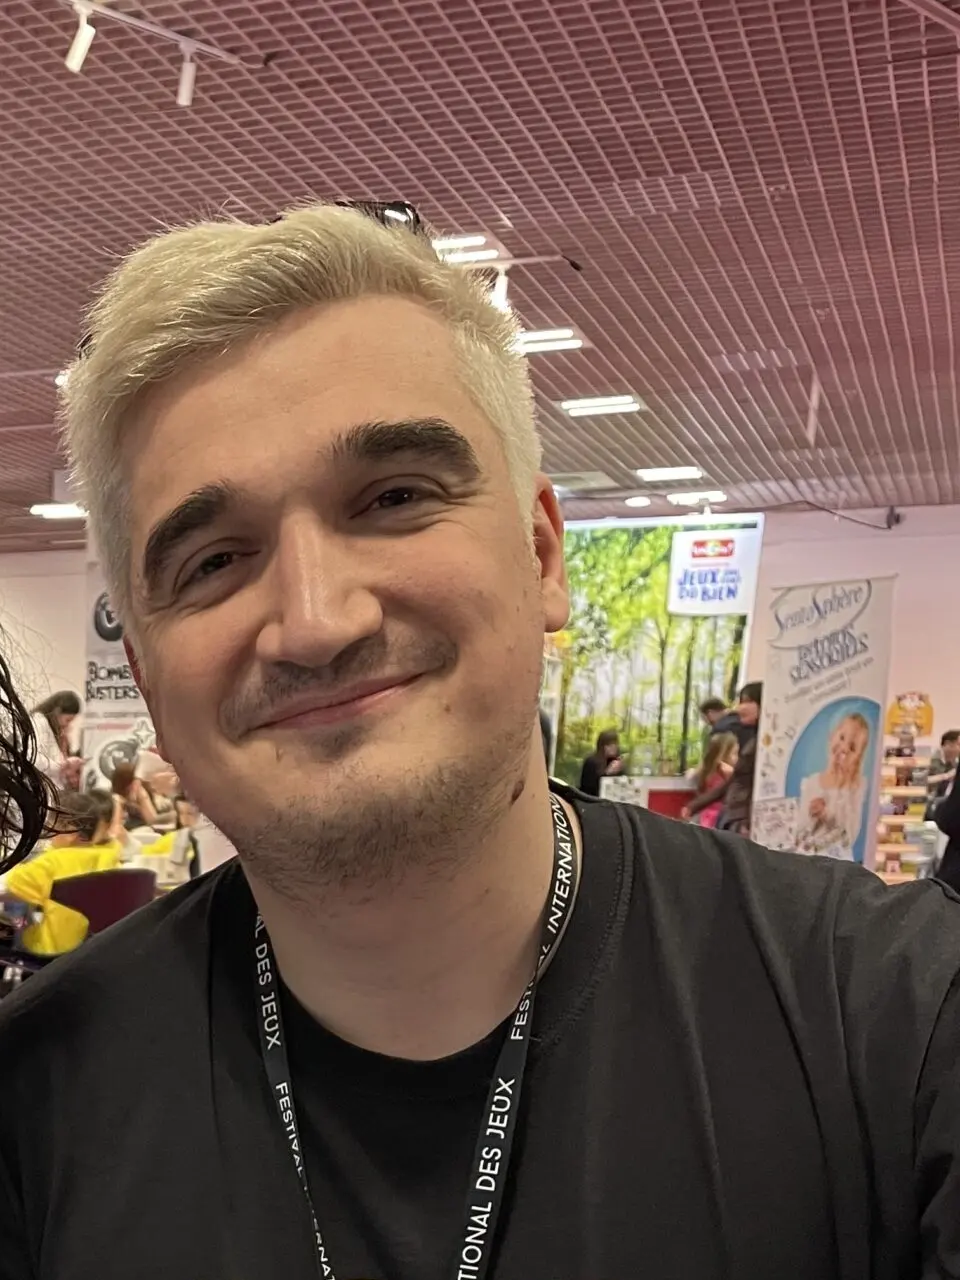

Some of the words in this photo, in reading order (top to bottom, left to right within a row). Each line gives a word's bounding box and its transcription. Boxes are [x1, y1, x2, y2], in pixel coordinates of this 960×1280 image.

[678, 568, 720, 586] JEUX
[701, 585, 738, 602] BIEN
[86, 681, 140, 701] BUSTERS
[255, 943, 272, 986] DES
[260, 991, 282, 1051] JEUX
[274, 1081, 304, 1178] FESTIVAL
[486, 1077, 516, 1139] JEUX
[476, 1146, 502, 1192] DES
